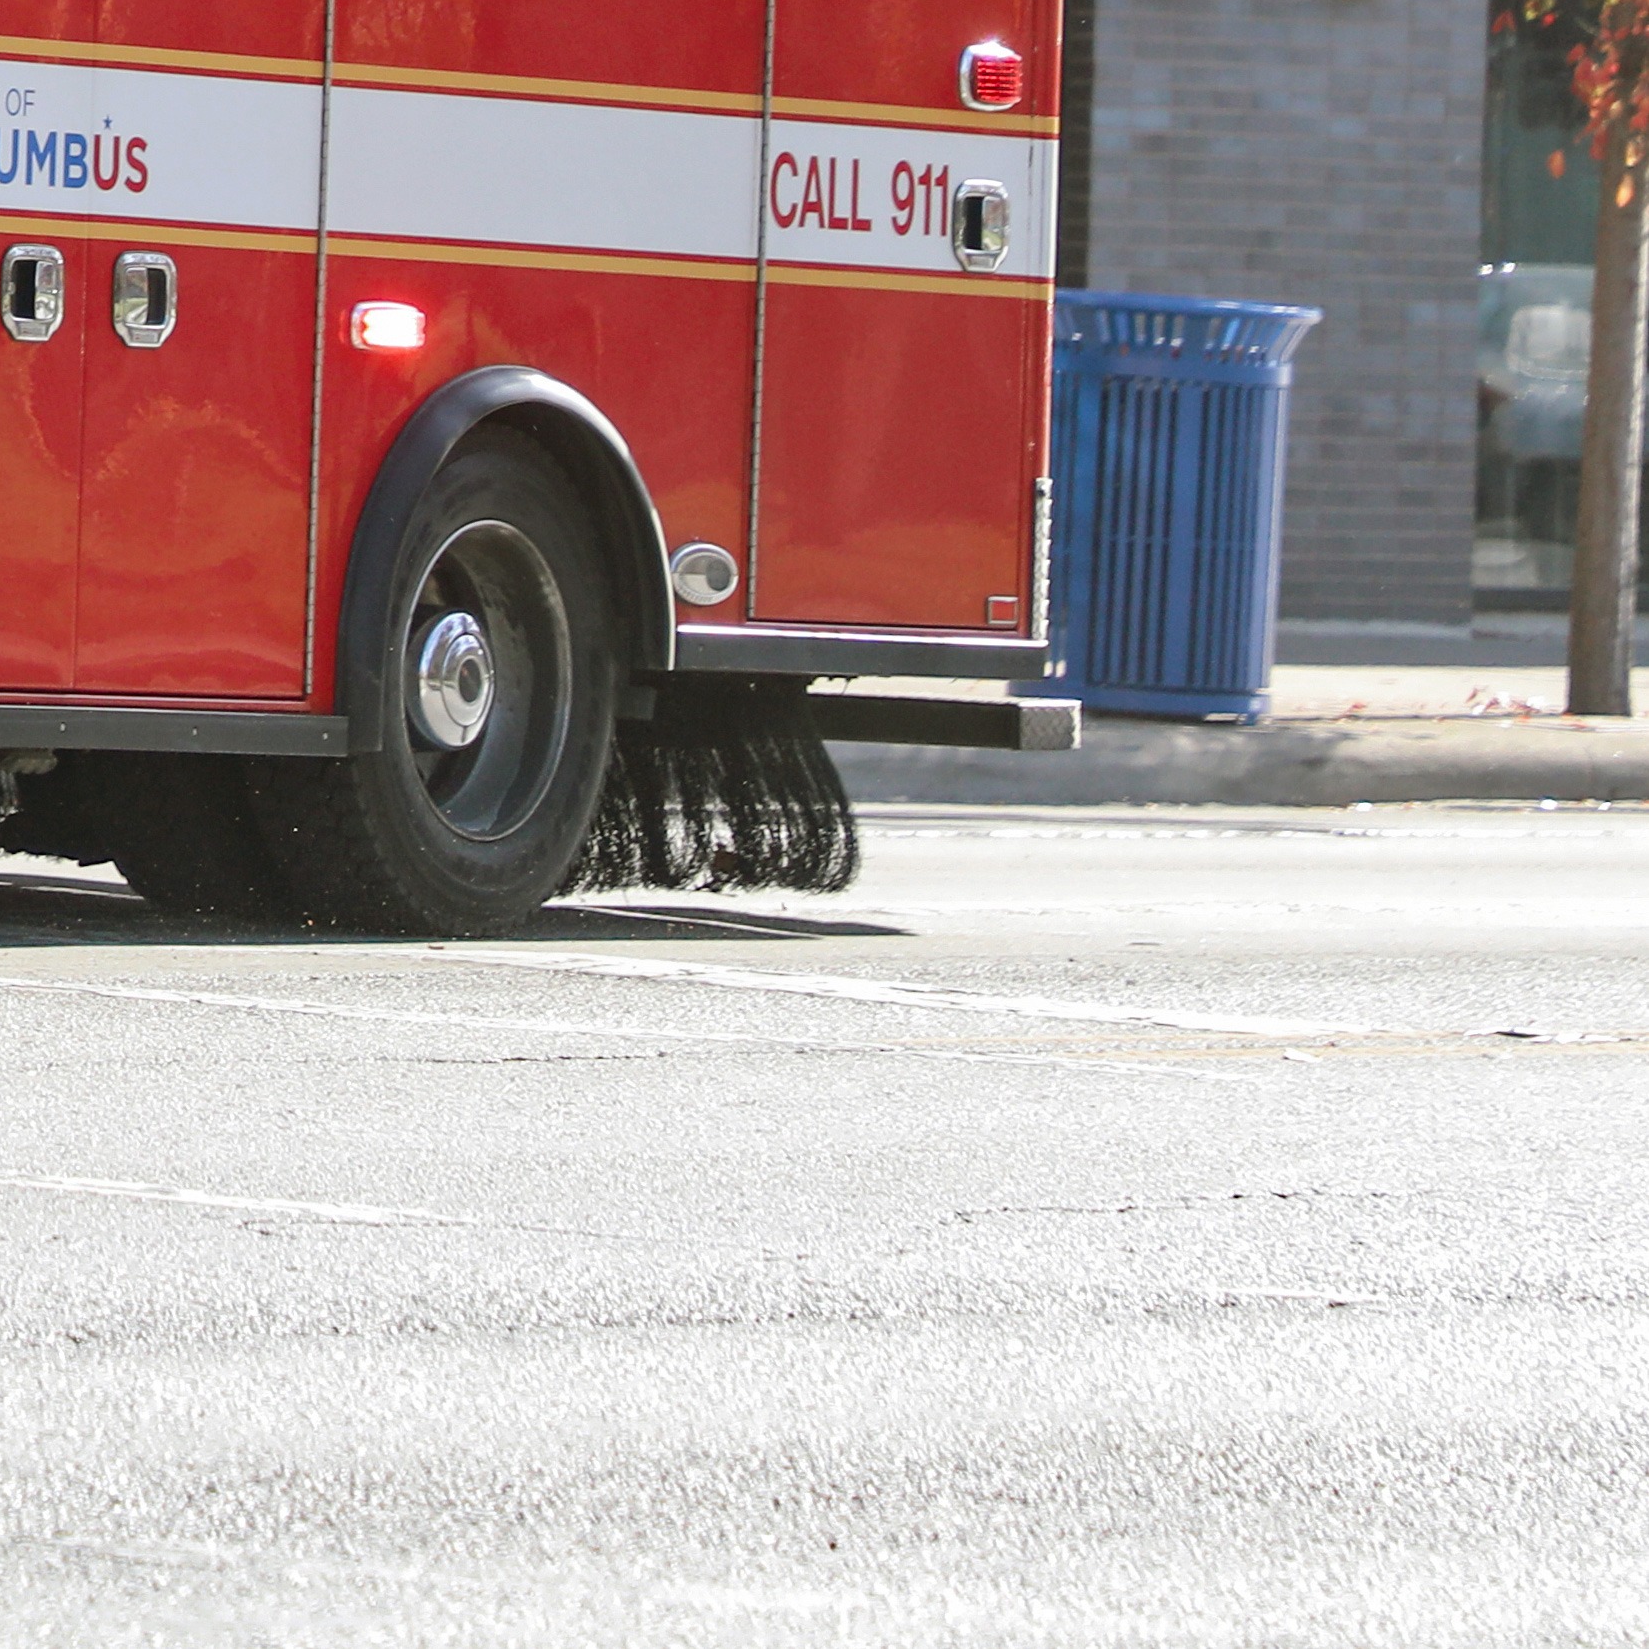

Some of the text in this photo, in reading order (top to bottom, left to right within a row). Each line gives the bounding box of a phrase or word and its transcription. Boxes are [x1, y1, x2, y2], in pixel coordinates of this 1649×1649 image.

[4, 88, 36, 116] OF
[770, 151, 949, 237] CALL 911
